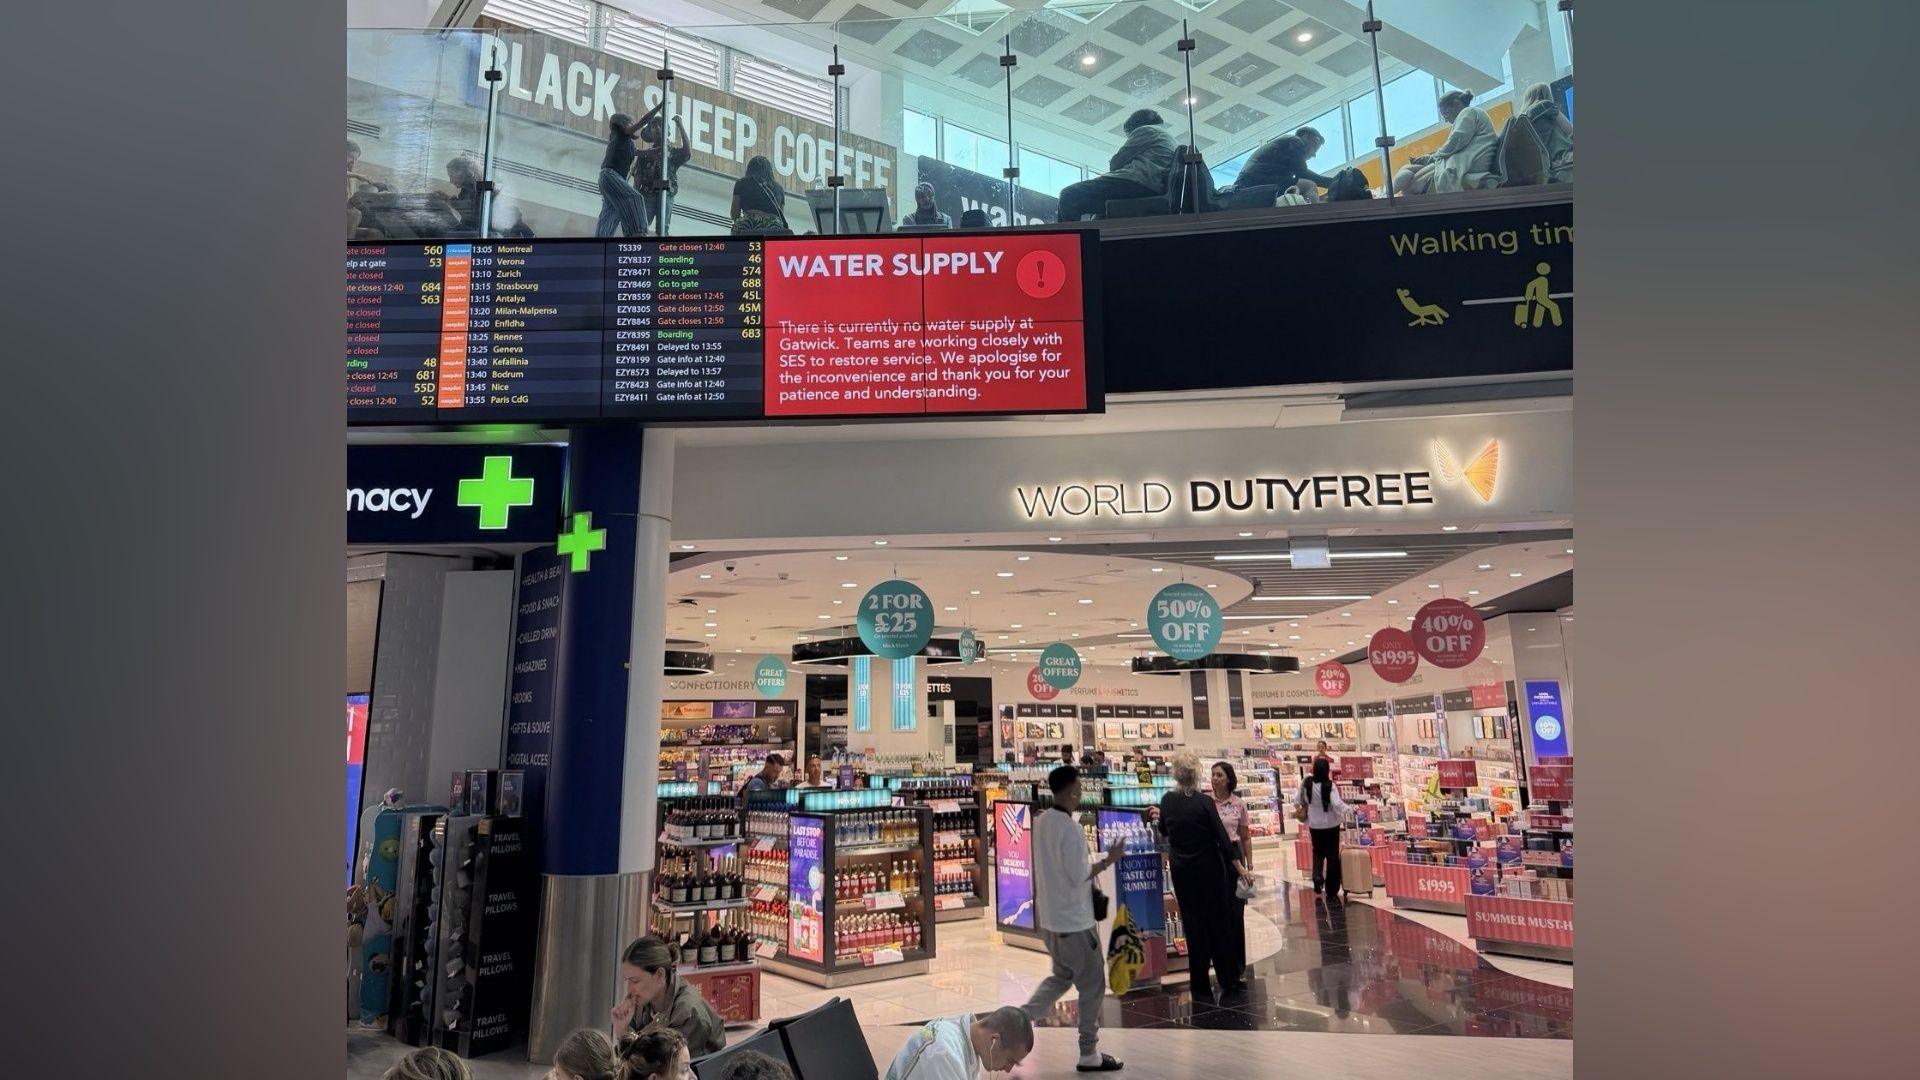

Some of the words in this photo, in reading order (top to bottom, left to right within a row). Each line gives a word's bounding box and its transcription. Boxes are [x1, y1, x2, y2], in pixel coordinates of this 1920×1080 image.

[477, 33, 621, 122] BLACK
[749, 243, 761, 251] 53
[1390, 228, 1519, 256] Walking
[658, 256, 694, 264] Boarding
[748, 255, 761, 263] 46
[779, 254, 884, 278] WATER
[892, 251, 1004, 276] SUPPLY
[496, 270, 521, 278] Zurich
[742, 267, 761, 275] 574
[496, 282, 539, 291] Strasbourg
[742, 279, 761, 287] 688
[495, 295, 525, 304] Antalya
[742, 291, 761, 300] 45L
[495, 307, 557, 316] Milan-Malpensa
[738, 303, 761, 312] 45M
[744, 315, 760, 325] 45J
[779, 321, 819, 334] There
[823, 322, 834, 333] is
[839, 320, 899, 335] currently
[903, 322, 921, 331] no
[926, 320, 965, 331] water
[969, 317, 1015, 333] supply
[1019, 318, 1033, 329] at
[617, 331, 650, 339] EZY8395
[657, 331, 693, 339] Boarding
[742, 329, 761, 338] 683
[779, 337, 840, 351] Gatwick.
[844, 337, 890, 349] Teams
[894, 338, 916, 348] are
[920, 335, 977, 350] working
[982, 333, 1028, 349] closely
[1032, 333, 1062, 345] with
[467, 358, 487, 366] 13:40
[616, 356, 650, 364] EZY8199
[779, 355, 806, 368] SES
[810, 356, 825, 366] to
[829, 355, 879, 366] restore
[883, 355, 936, 365] service.
[940, 352, 965, 364] We
[969, 351, 1037, 367] apologise
[1041, 350, 1061, 362] for
[779, 372, 802, 384] the
[806, 371, 906, 383] inconvenience
[910, 369, 937, 381] and
[942, 368, 980, 381] thank
[985, 370, 1010, 382] you
[1015, 367, 1034, 379] for
[1039, 368, 1070, 380] your
[615, 381, 649, 389] EZY8423
[491, 396, 510, 404] Paris
[512, 395, 529, 403] CdG
[779, 388, 839, 404] patience
[844, 387, 870, 399] and
[874, 385, 981, 400] understanding.
[1016, 483, 1173, 518] WORLD
[1189, 471, 1434, 513] DUTYFREE
[869, 595, 878, 609] 2
[882, 594, 923, 609] FOR
[1157, 600, 1211, 618] 50%
[875, 612, 917, 633] £25
[1421, 614, 1474, 633] 40%
[1162, 622, 1210, 641] OFF
[1426, 635, 1473, 653] OFF
[1046, 657, 1075, 666] GREAT
[1372, 650, 1416, 665] £19.95
[760, 669, 782, 677] GREAT
[1042, 668, 1079, 676] OFFERS
[1320, 669, 1345, 679] 20%
[757, 678, 785, 687] OFFERS
[1032, 674, 1043, 683] 20
[670, 680, 756, 690] CONFECTIONERY
[1322, 680, 1344, 690] OFF
[793, 825, 807, 836] LAST
[807, 827, 821, 837] STOP
[494, 833, 520, 842] TRAVEL
[491, 844, 522, 854] PILLOWS
[1120, 870, 1145, 880] TASTE
[1146, 870, 1157, 879] OF
[1122, 881, 1157, 891] SUMMER
[1418, 878, 1455, 894] £19.95
[488, 891, 516, 903] TRAVEL
[484, 902, 518, 916] PILLOWS
[1475, 911, 1526, 927] SUMMER
[1528, 917, 1573, 931] MUST-H
[482, 952, 512, 964] TRAVEL
[479, 962, 513, 977] PILLOWS
[476, 1013, 507, 1026] TRAVEL
[472, 1024, 509, 1041] PILLOWS
